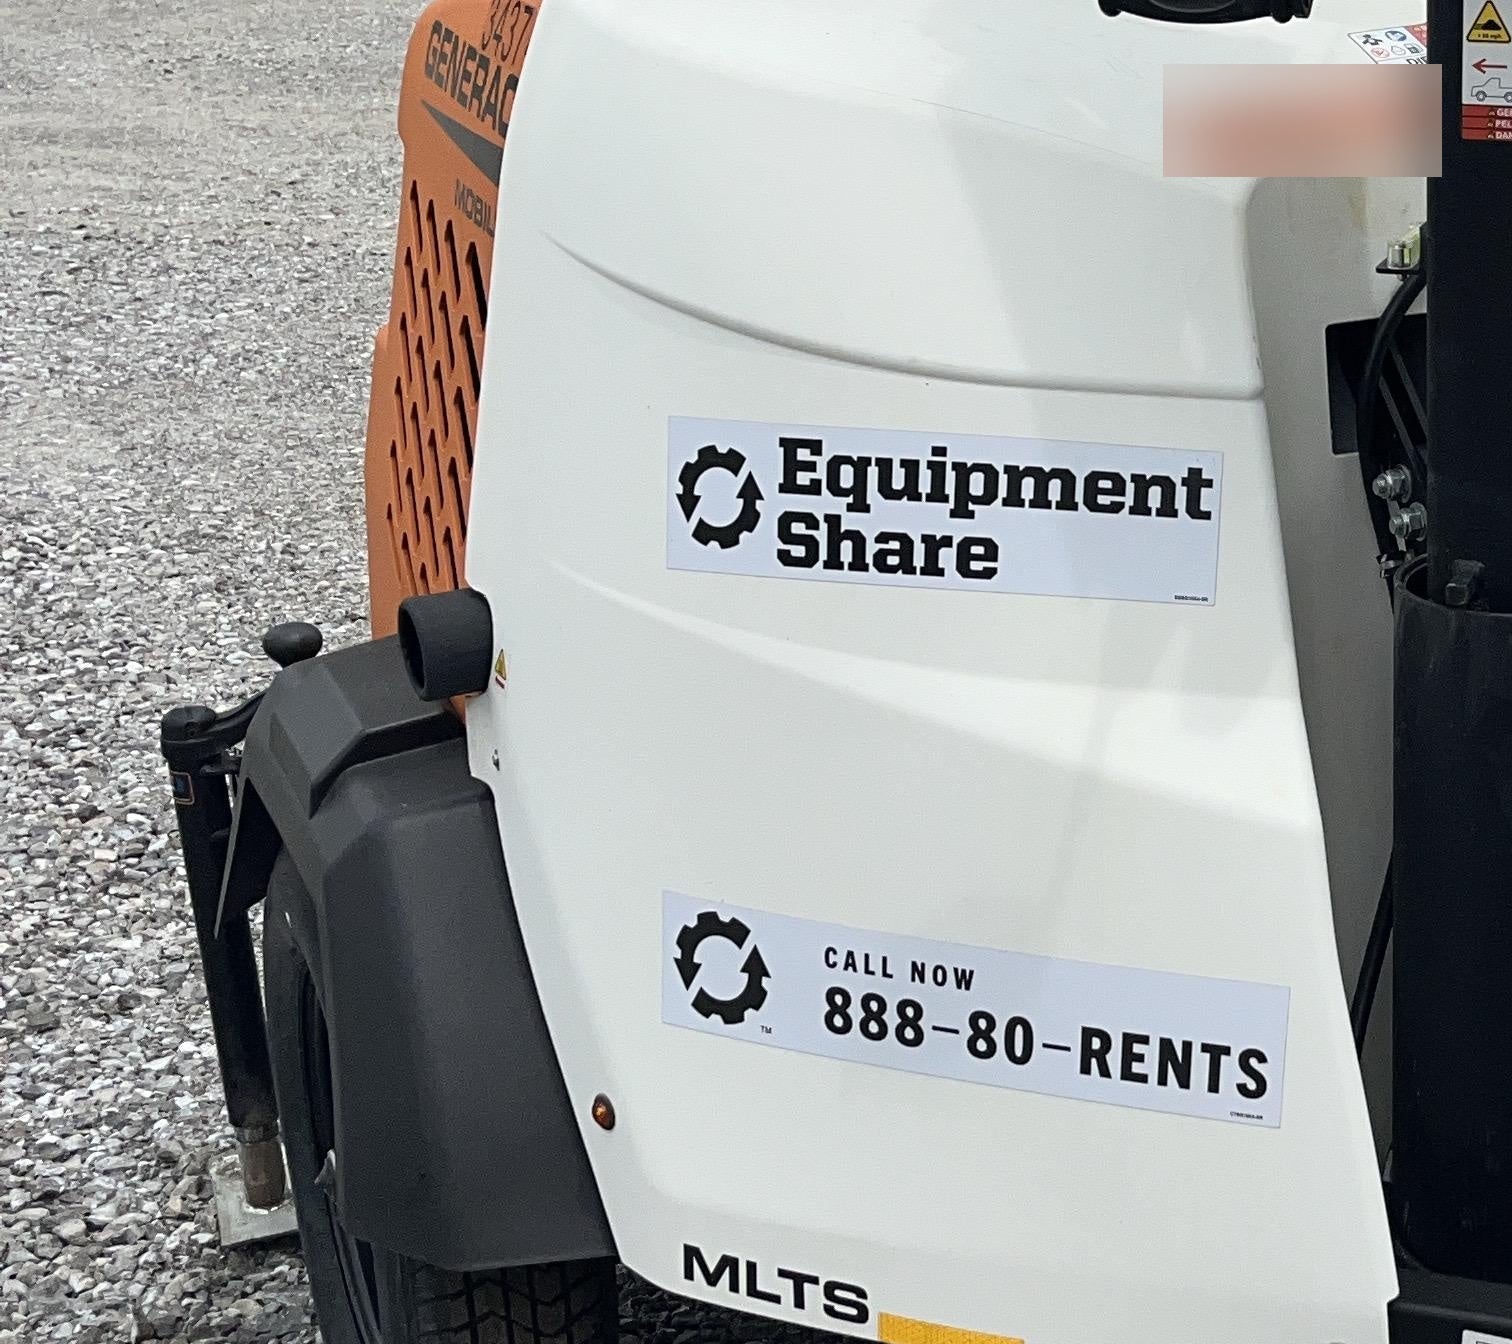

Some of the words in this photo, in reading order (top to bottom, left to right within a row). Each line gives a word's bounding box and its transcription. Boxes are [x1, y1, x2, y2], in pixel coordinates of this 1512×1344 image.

[424, 19, 519, 140] GENERAC
[777, 436, 1214, 522] Equipment
[776, 509, 999, 580] Share
[823, 945, 895, 980] CALL
[910, 960, 977, 992] NOW
[823, 985, 1270, 1101] 888-80-RENTS
[683, 1242, 870, 1325] MLTS
